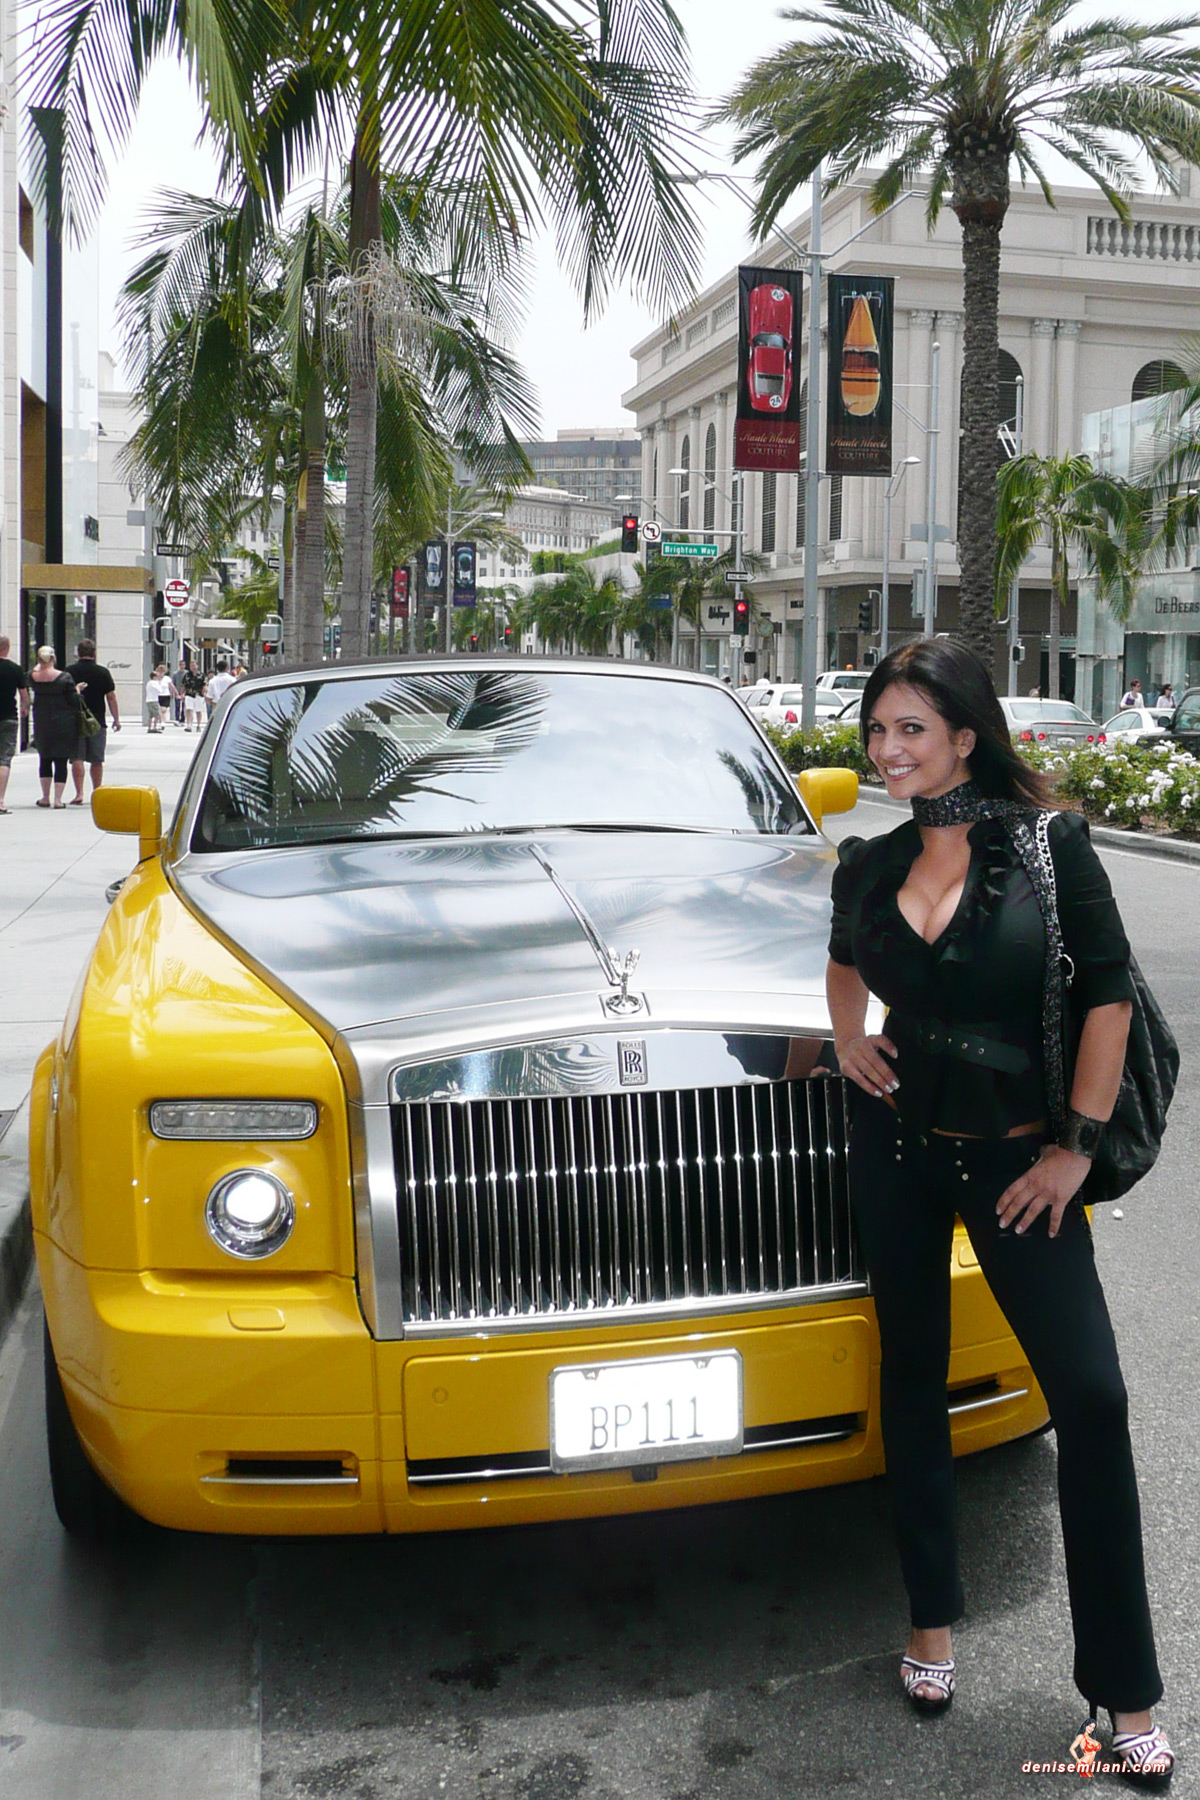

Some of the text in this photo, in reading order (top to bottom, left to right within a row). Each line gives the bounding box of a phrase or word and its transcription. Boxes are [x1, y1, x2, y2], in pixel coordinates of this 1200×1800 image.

[769, 430, 796, 444] Wheels
[665, 545, 715, 555] Brighton Way
[107, 660, 132, 669] Cartier
[589, 1396, 704, 1450] BP111
